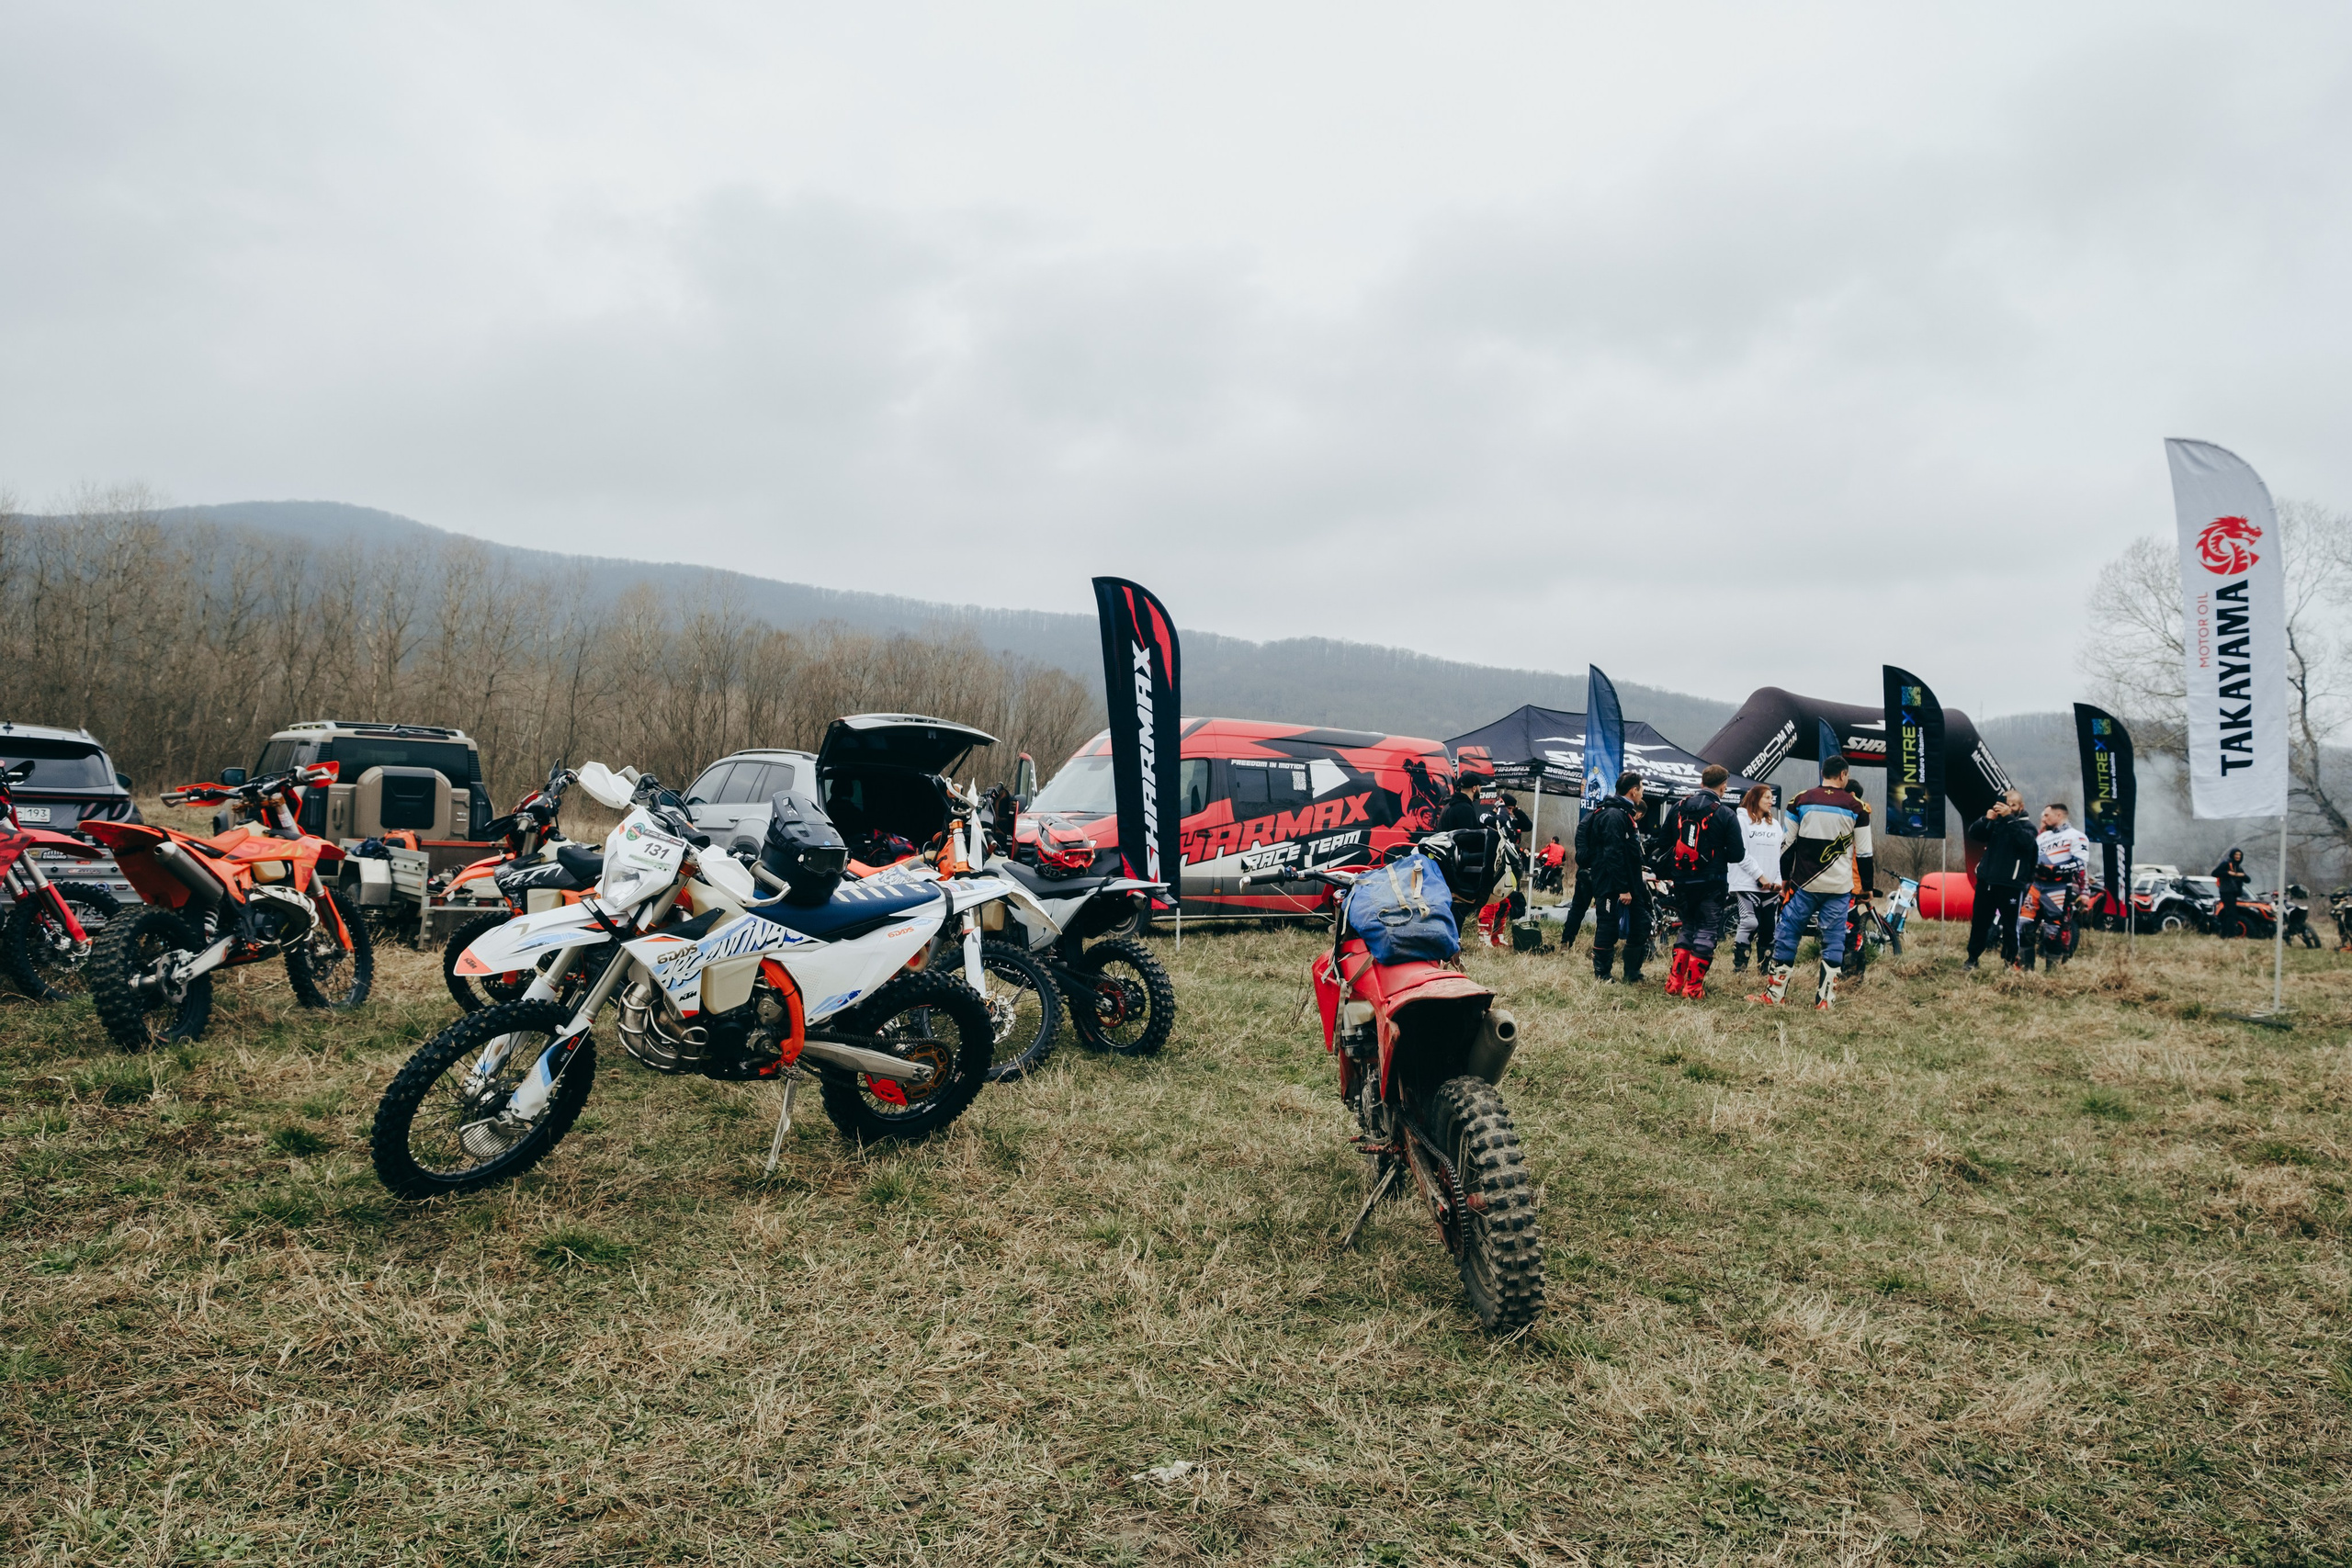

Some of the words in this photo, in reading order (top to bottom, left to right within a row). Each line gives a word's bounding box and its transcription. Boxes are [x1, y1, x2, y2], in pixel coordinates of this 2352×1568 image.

[2197, 592, 2209, 615] OIL
[2199, 617, 2211, 668] MOTOR
[2215, 579, 2254, 777] TAKAYAMA
[1783, 719, 1795, 734] IN
[1917, 727, 1926, 756] vitamins
[1131, 639, 1161, 884] SHARMAX
[1230, 759, 1268, 768] FREEDOM
[1278, 762, 1306, 771] MOTION
[27, 808, 47, 818] 193
[1748, 830, 1766, 839] JUST
[644, 842, 670, 860] 131
[1246, 842, 1302, 872] RACE
[1307, 829, 1362, 856] TEAM
[887, 926, 915, 939] 6DAYS
[656, 942, 699, 964] 6DAYS
[463, 957, 478, 970] KTM
[678, 990, 698, 1002] KTM
